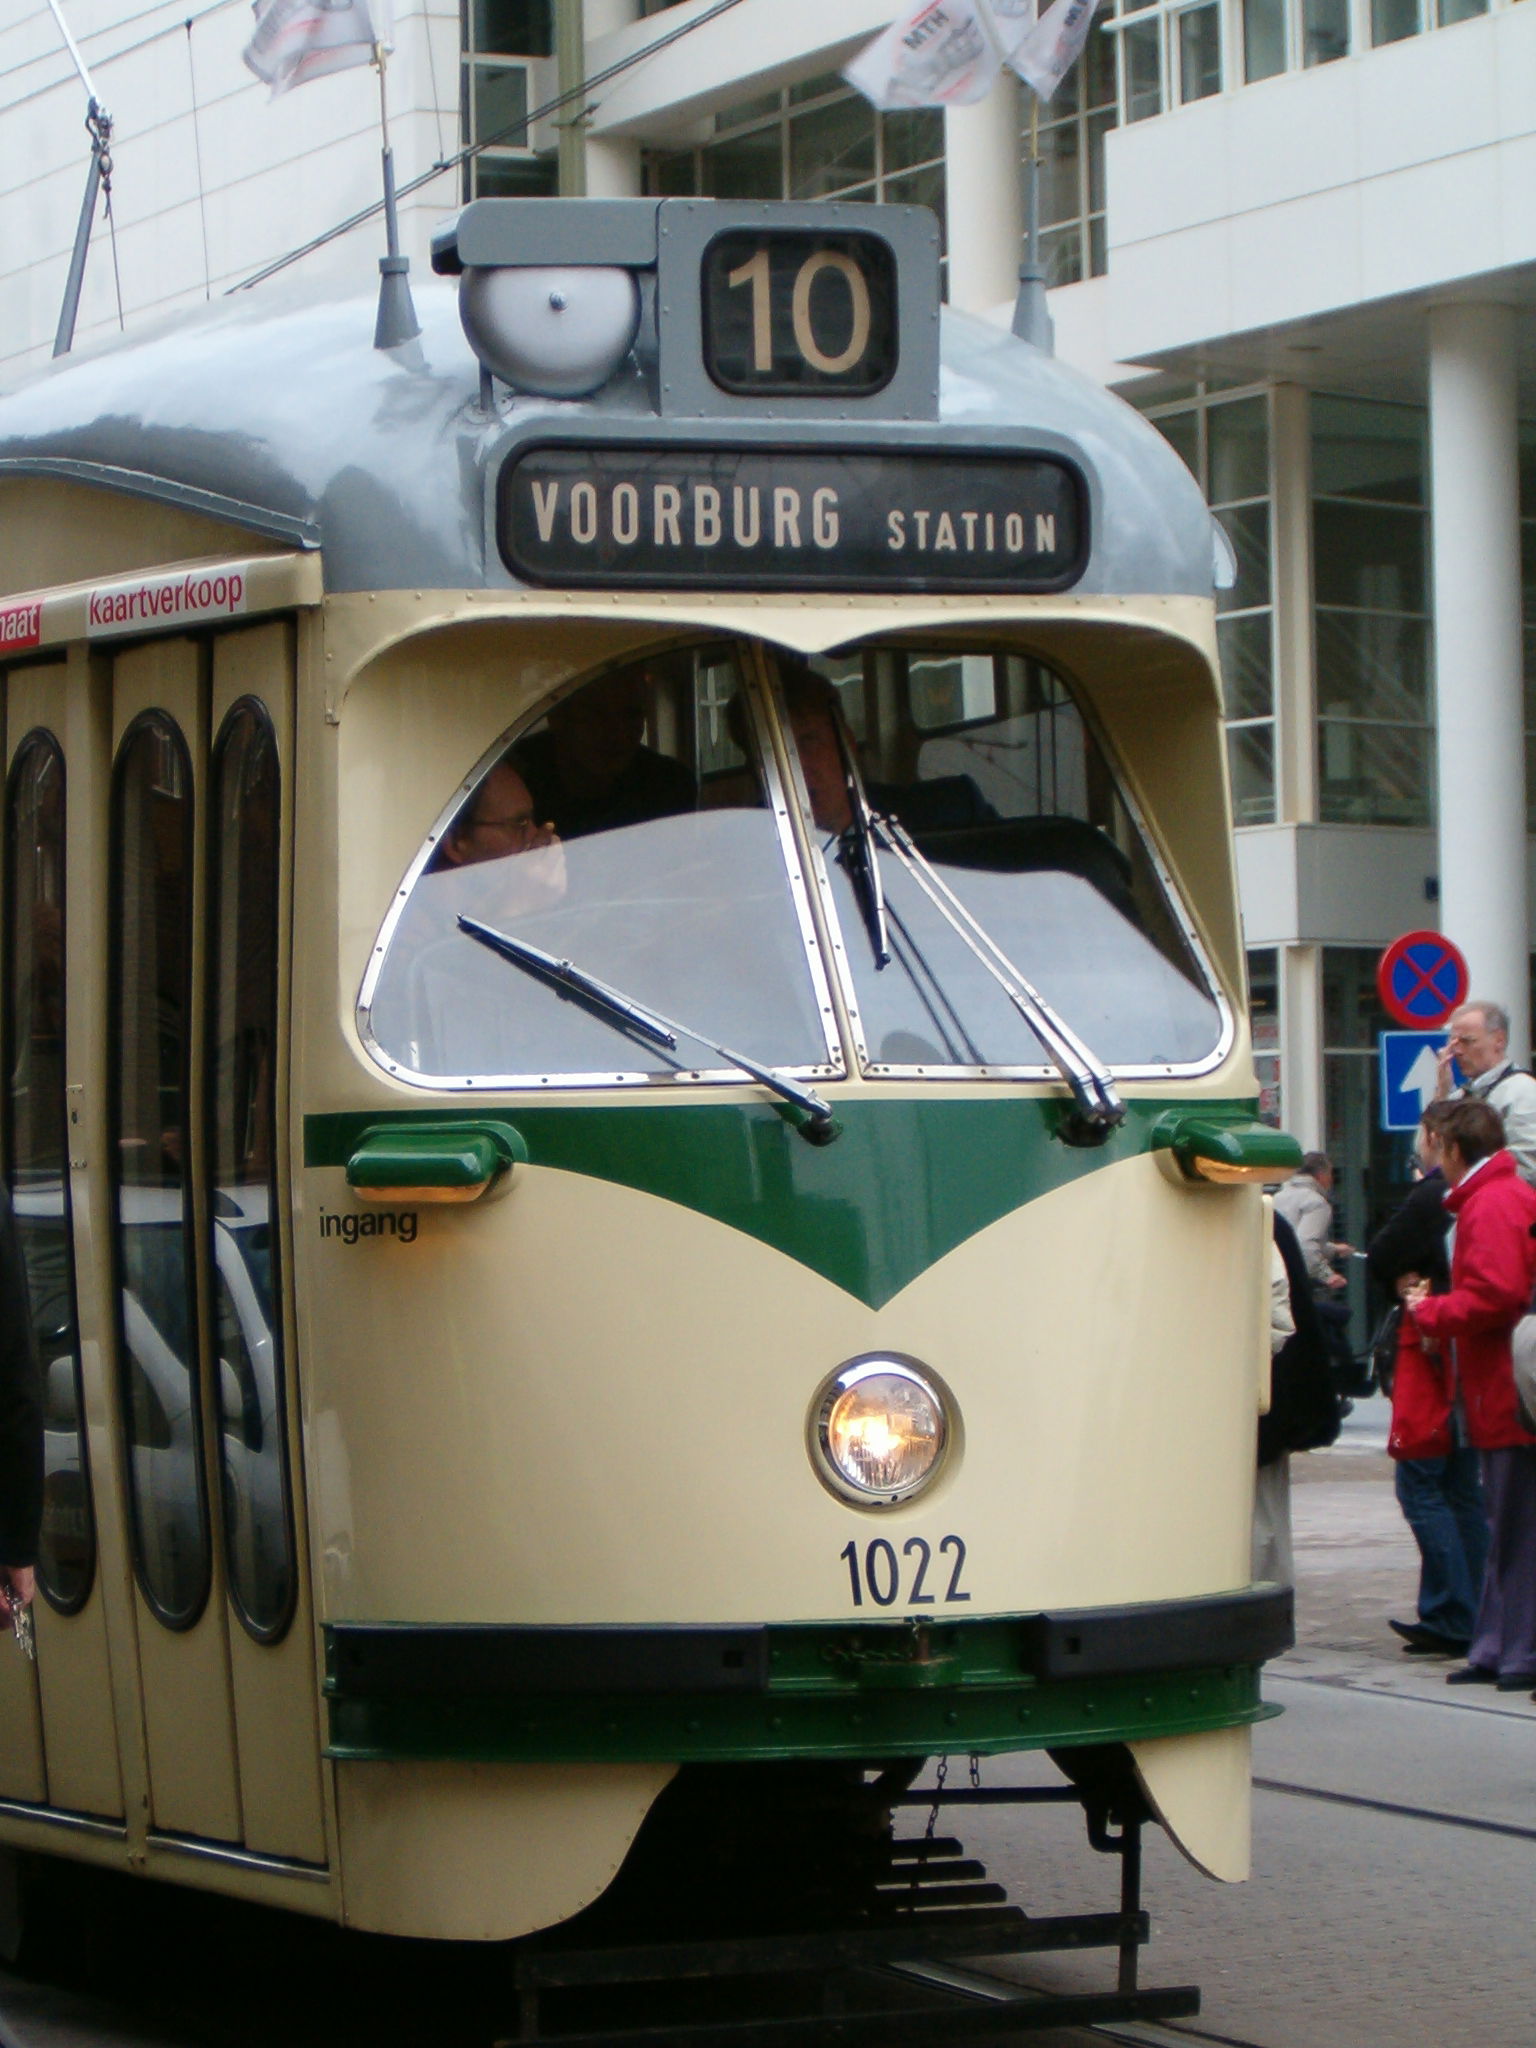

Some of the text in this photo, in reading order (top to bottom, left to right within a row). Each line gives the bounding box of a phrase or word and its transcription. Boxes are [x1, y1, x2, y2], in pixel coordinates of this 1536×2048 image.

[728, 249, 872, 375] 10
[531, 481, 1056, 553] VOORBURG STATION
[89, 574, 243, 626] kaartverkoop
[319, 1206, 418, 1245] ingang
[840, 1534, 971, 1606] 1022
